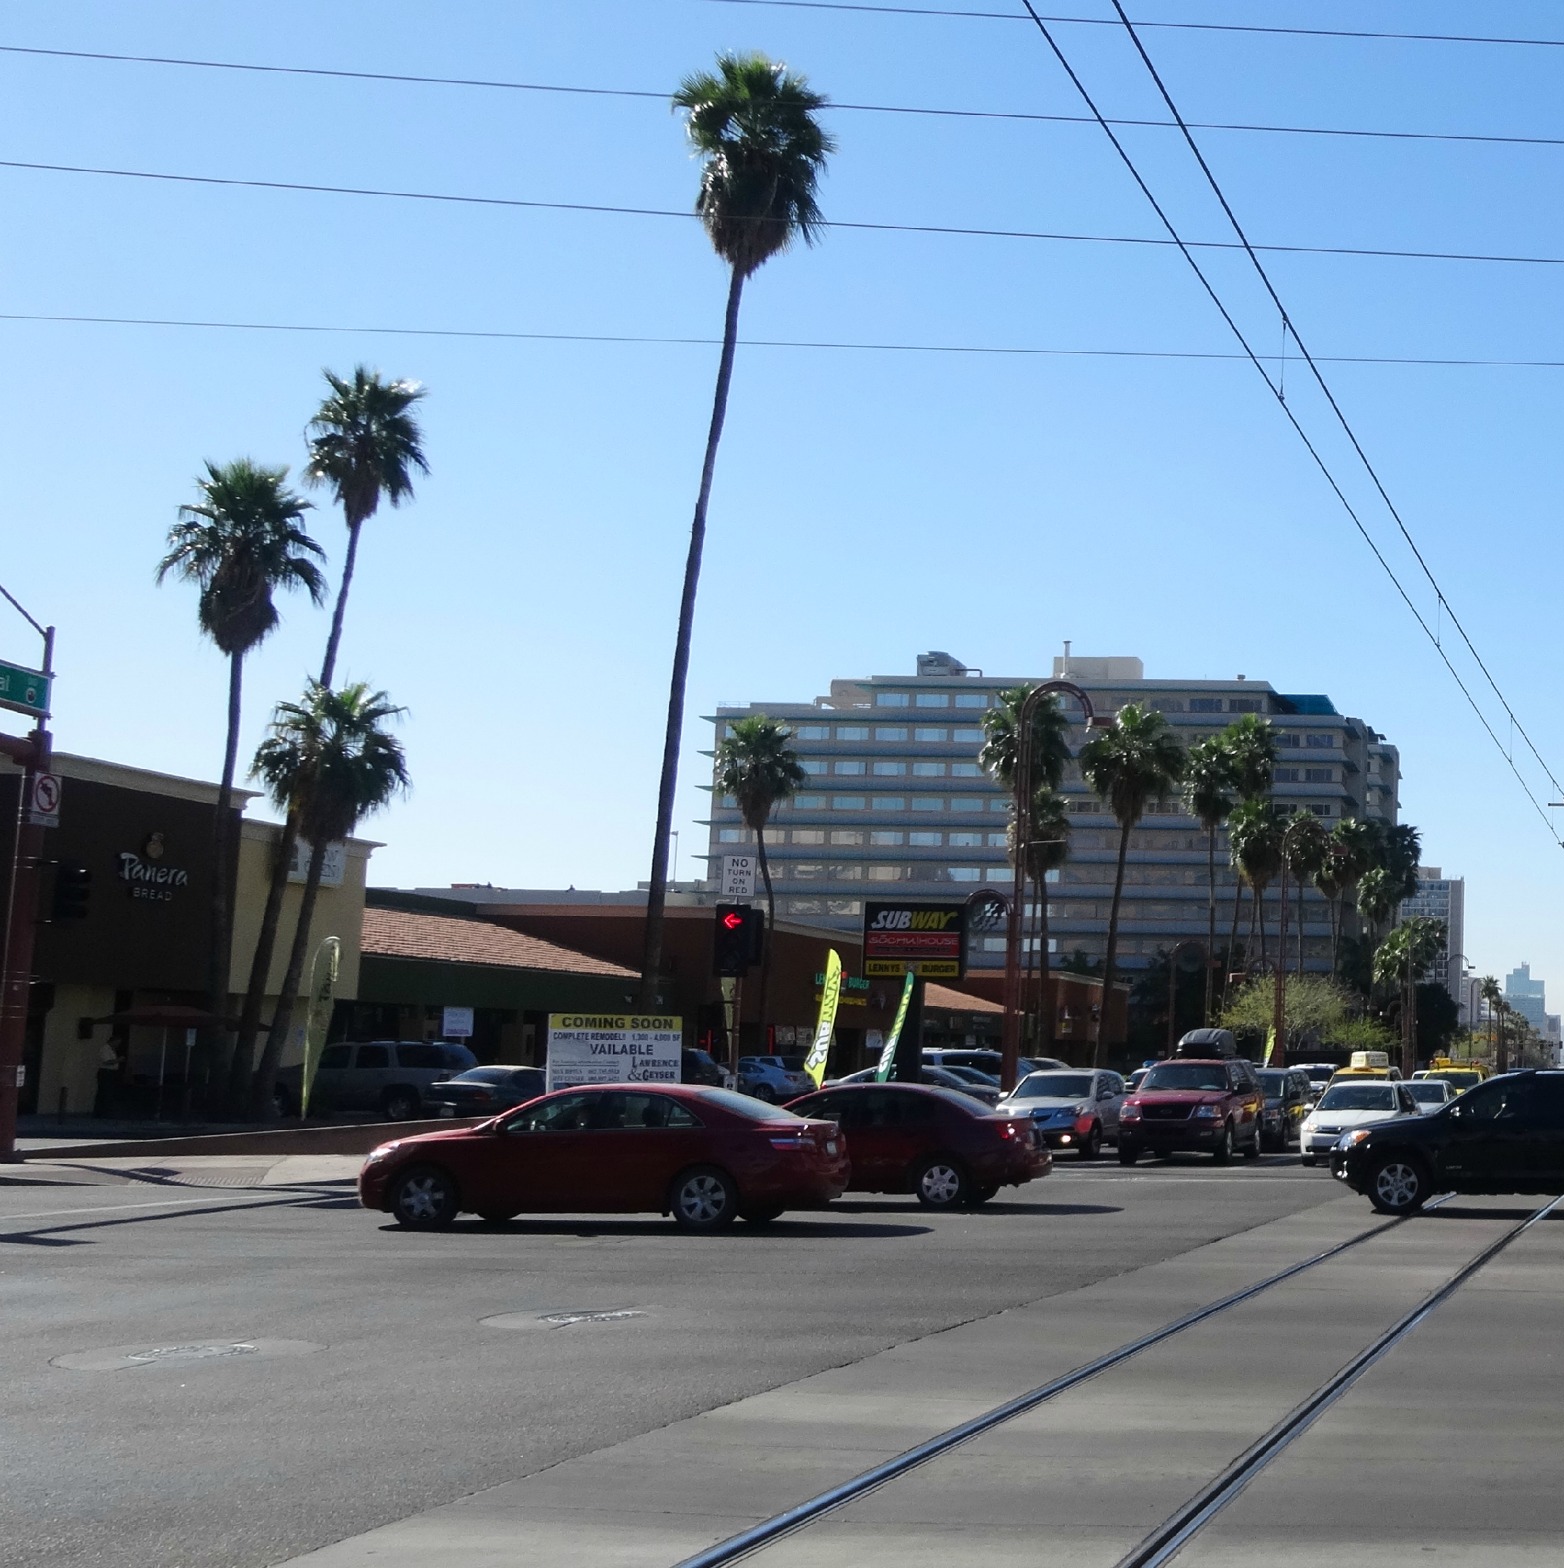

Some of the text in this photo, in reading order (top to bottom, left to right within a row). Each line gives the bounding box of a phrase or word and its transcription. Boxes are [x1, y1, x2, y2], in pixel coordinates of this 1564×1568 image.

[120, 852, 188, 885] Panera
[731, 858, 749, 867] NO
[133, 887, 173, 901] BREAD
[871, 911, 959, 929] SUBWAY
[918, 937, 960, 945] HOUSE
[922, 964, 956, 973] BURGER
[562, 1016, 674, 1029] COMING SOON
[806, 966, 841, 1070] SUBWAY
[553, 1032, 590, 1040] COMPLETE
[589, 1043, 654, 1055] VAILABLE
